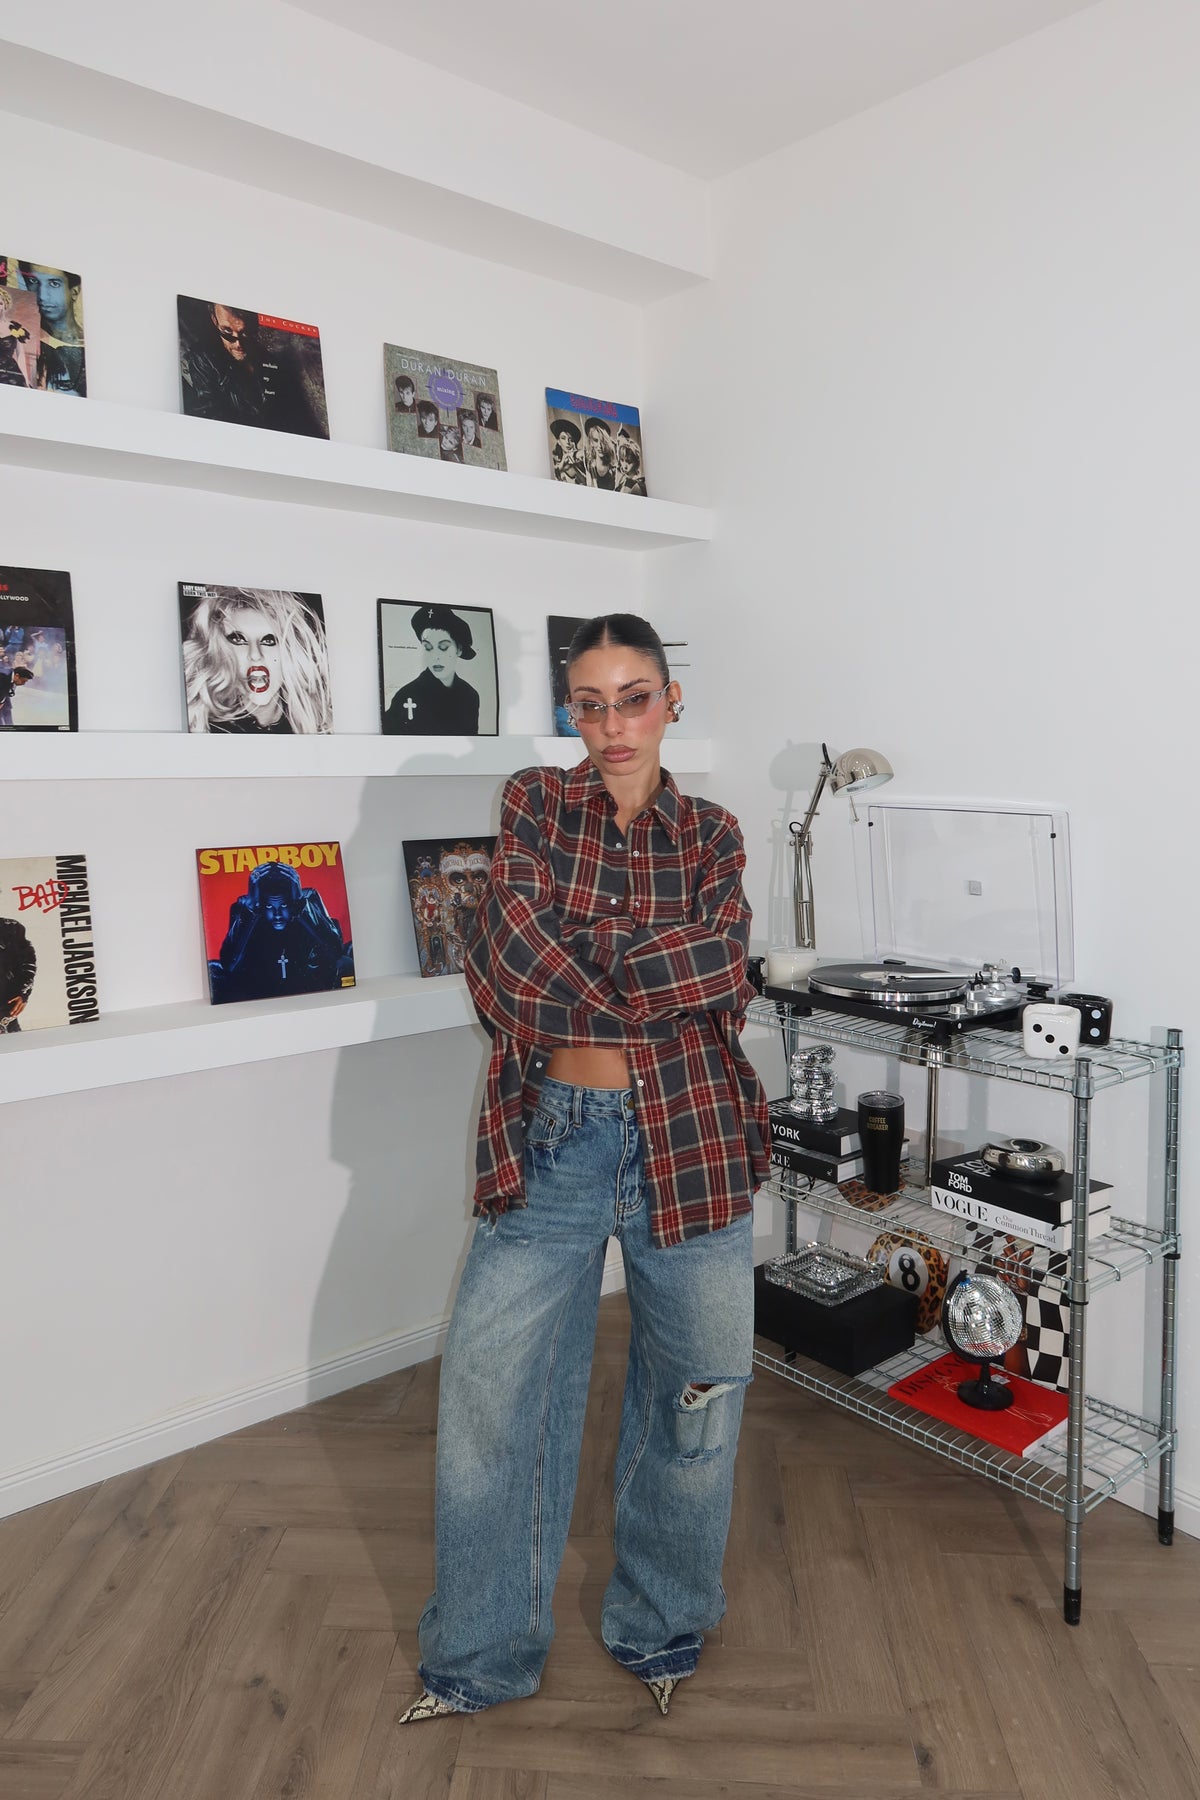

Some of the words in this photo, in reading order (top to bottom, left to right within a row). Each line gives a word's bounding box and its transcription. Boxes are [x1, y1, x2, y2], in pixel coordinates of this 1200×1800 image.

[401, 359, 442, 376] DURAN
[447, 369, 486, 387] DURAN
[436, 386, 455, 396] mixing
[0, 594, 29, 602] LLYWOOD
[200, 843, 339, 875] STARBOY
[12, 878, 68, 913] BAD
[55, 855, 92, 937] MICHAEL
[62, 941, 100, 1025] JACKSON
[772, 1123, 800, 1141] YORK
[771, 1152, 791, 1167] OGUE
[948, 1171, 968, 1184] TOM
[948, 1179, 973, 1193] FORD
[934, 1190, 988, 1222] VOGUE
[995, 1216, 1029, 1235] Common
[1029, 1226, 1057, 1244] Thread
[898, 1253, 920, 1292] 8
